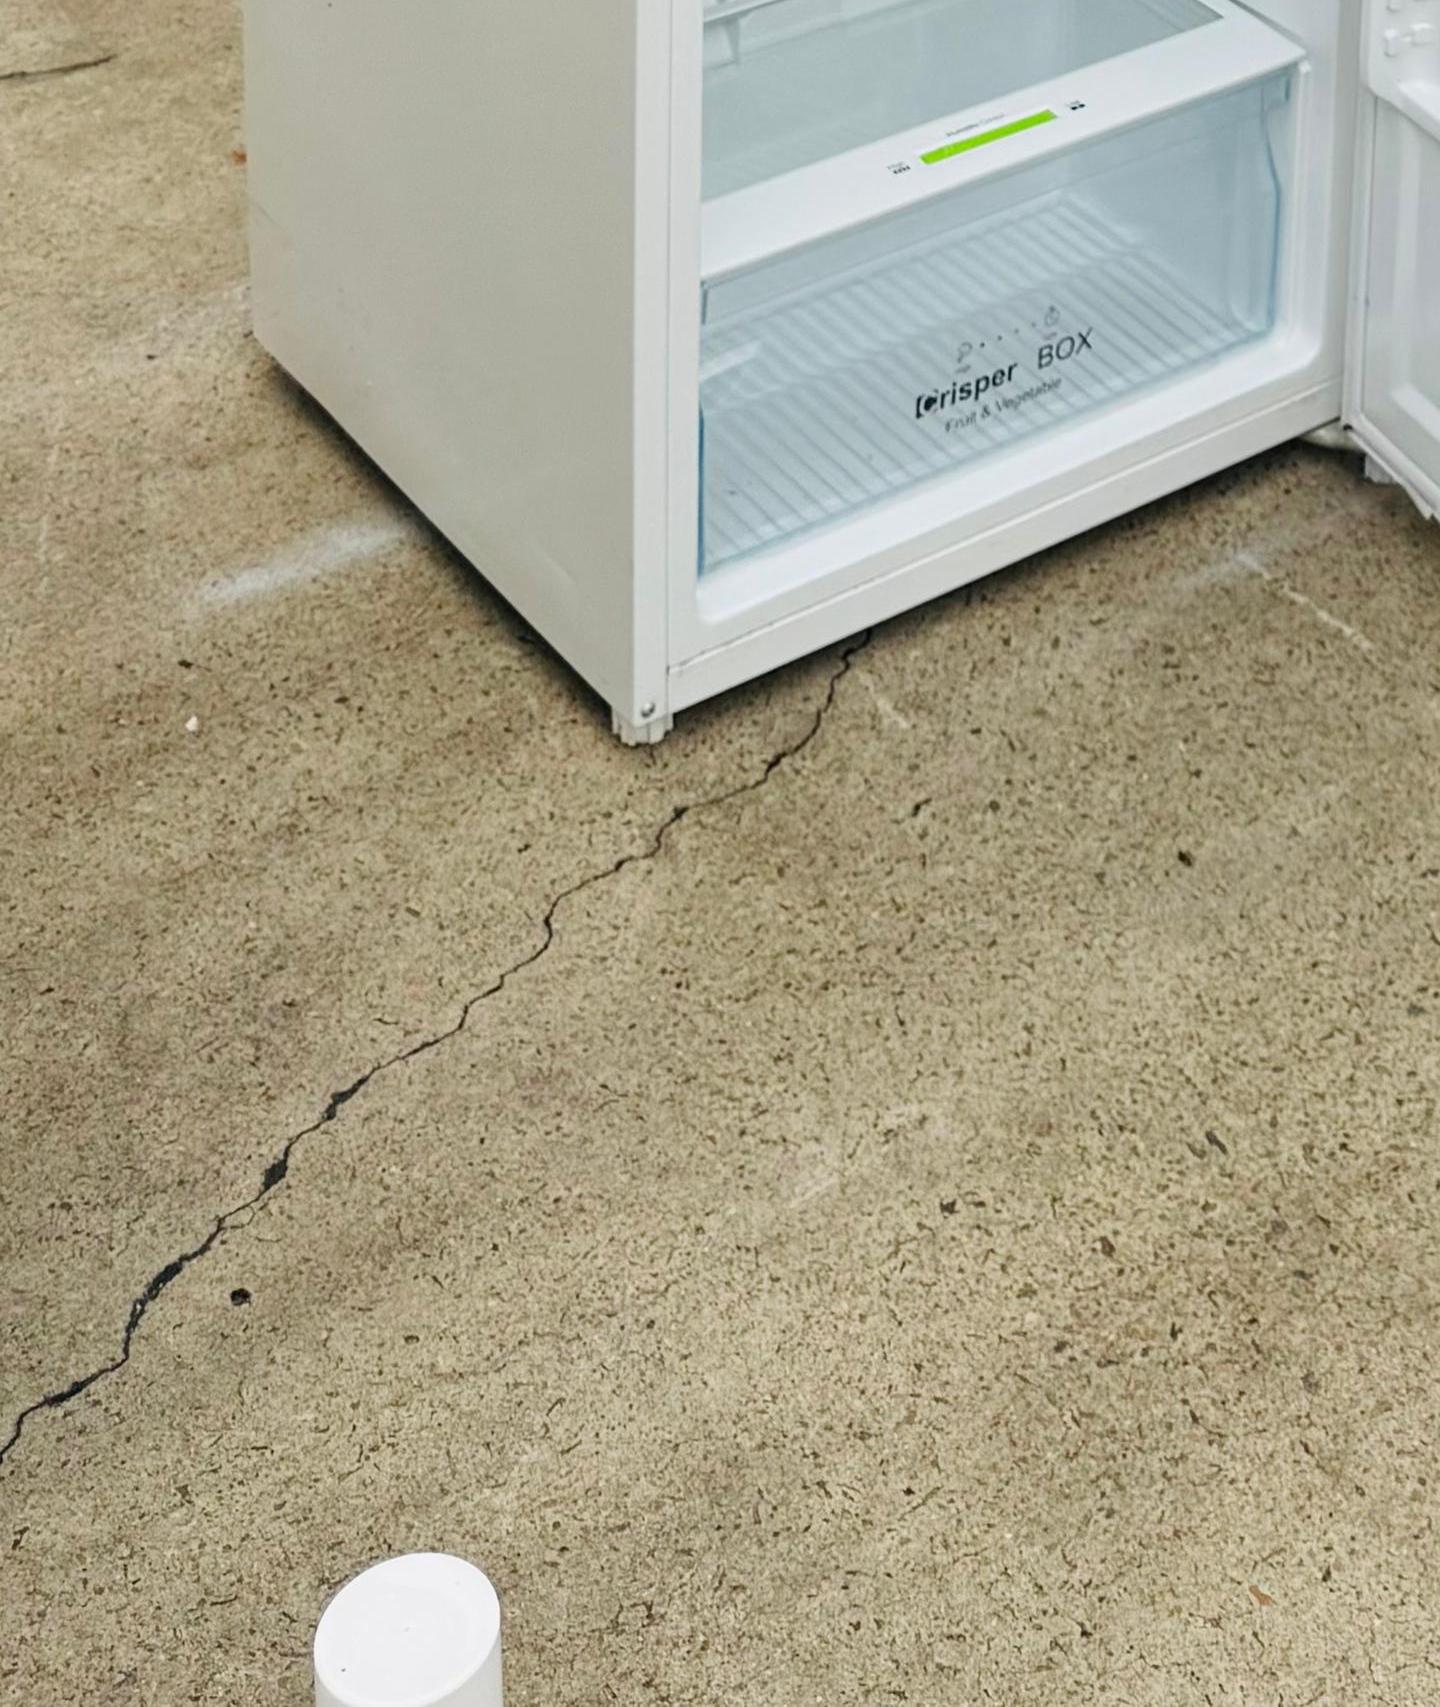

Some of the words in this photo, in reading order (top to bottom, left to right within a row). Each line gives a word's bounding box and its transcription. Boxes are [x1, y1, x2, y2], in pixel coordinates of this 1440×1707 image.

[914, 361, 1019, 419] Crisper
[1037, 326, 1094, 370] BOX
[944, 410, 977, 433] Fruit
[980, 405, 991, 420] &
[995, 377, 1063, 412] Vegetable
